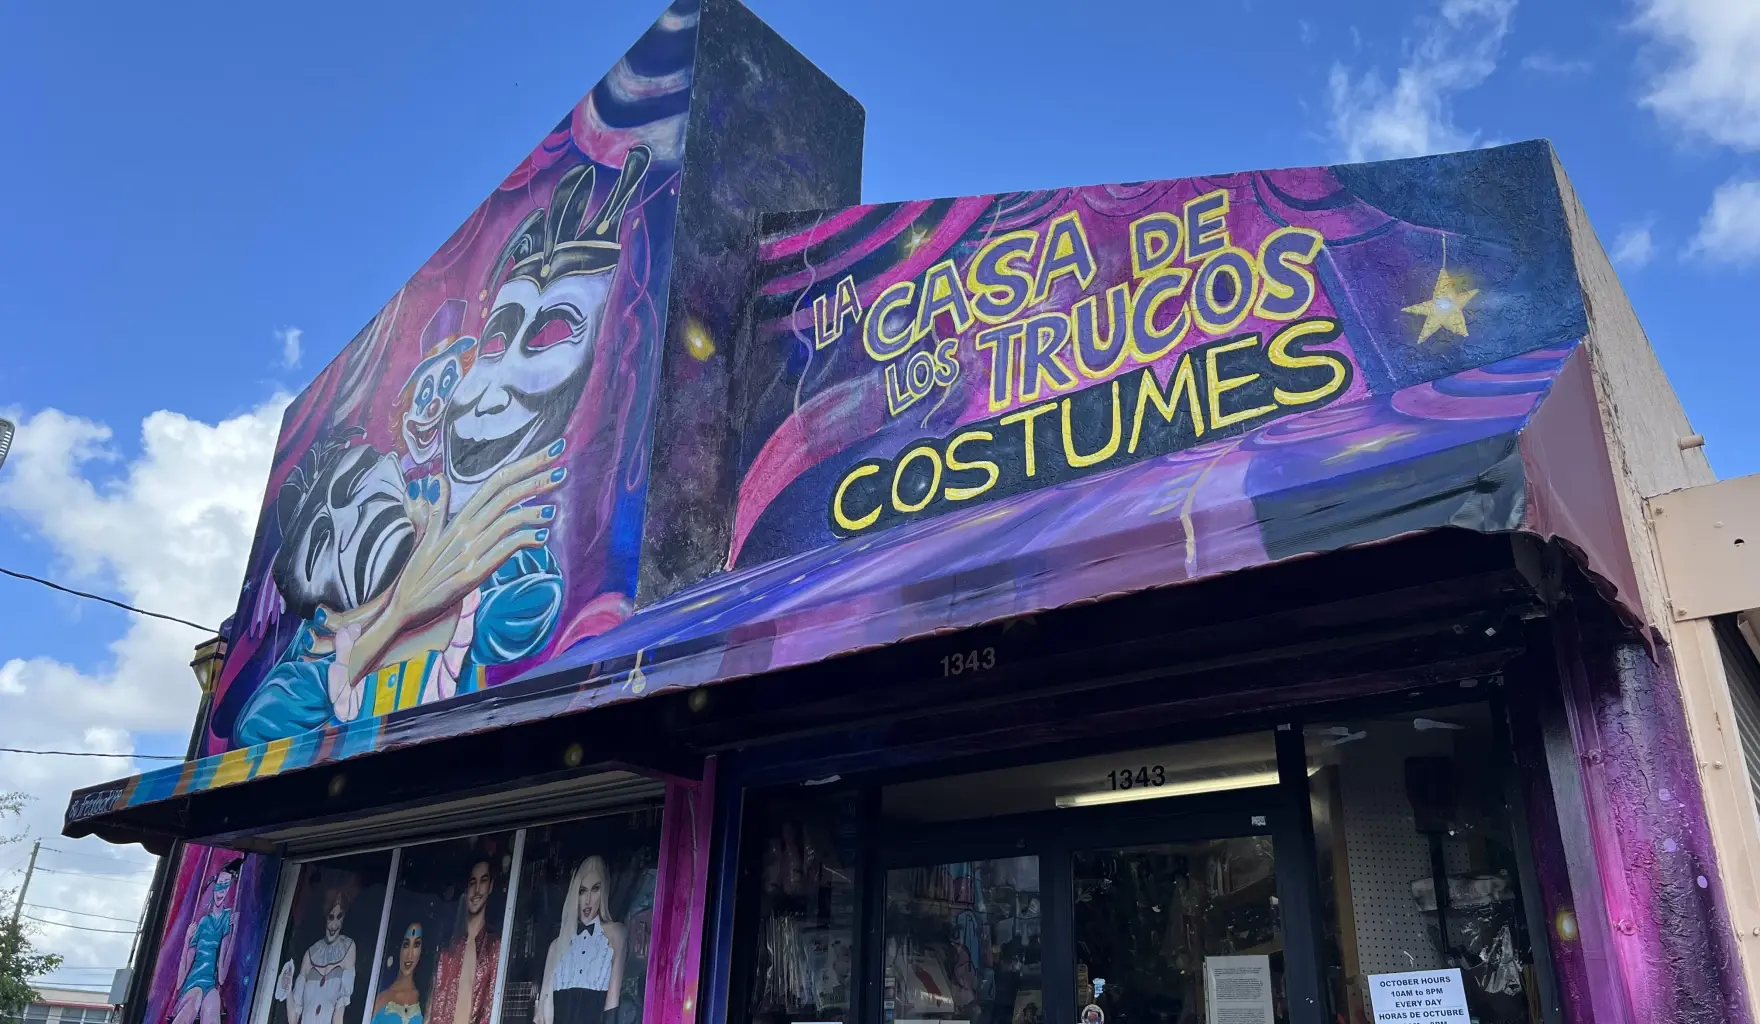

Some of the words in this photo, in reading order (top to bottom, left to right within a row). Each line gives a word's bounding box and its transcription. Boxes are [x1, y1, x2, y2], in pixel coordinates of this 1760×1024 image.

[812, 275, 865, 350] LA
[862, 210, 1098, 361] CASA
[1132, 188, 1230, 278] DE
[884, 338, 960, 419] LOS
[975, 226, 1324, 412] TRUCOS
[834, 320, 1347, 530] COSTUMES
[940, 647, 996, 677] 1343
[1107, 765, 1166, 791] 1343
[1380, 978, 1419, 987] OCTOBER
[1421, 976, 1450, 984] HOURS
[1391, 990, 1413, 998] 10AM
[1379, 1012, 1408, 1021] HORAS
[1409, 1010, 1421, 1019] DE
[1423, 1008, 1464, 1017] OCTUBRE
[1395, 1000, 1423, 1008] EVERY
